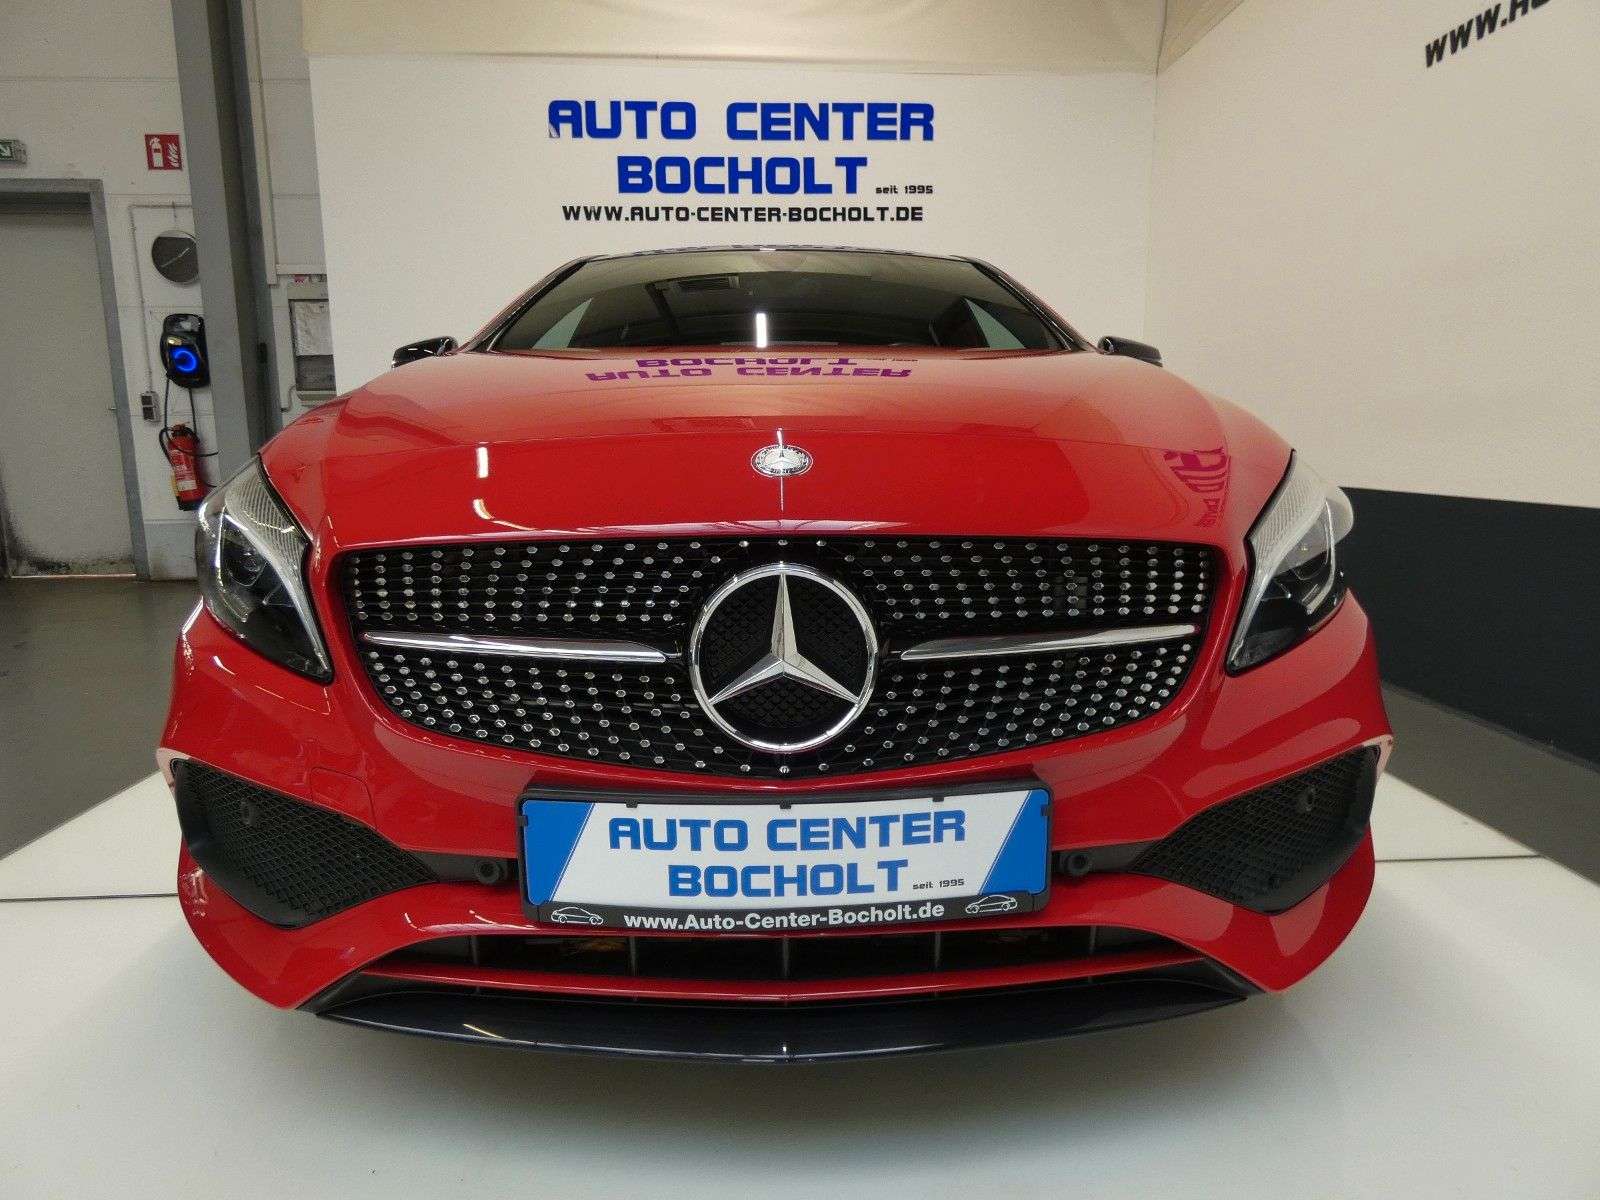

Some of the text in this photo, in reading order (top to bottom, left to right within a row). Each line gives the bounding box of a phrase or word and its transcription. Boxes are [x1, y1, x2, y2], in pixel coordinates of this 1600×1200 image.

[548, 100, 935, 141] AUTO CENTER
[617, 155, 868, 194] BOCHOLT
[875, 184, 934, 194] seit 1995
[562, 205, 924, 222] WWW.AUTO-CENTER-BOCHOLT.DE
[608, 809, 967, 852] AUTO CENTER
[668, 859, 908, 895] BOCHOLT
[912, 878, 966, 890] seit 1995
[623, 899, 946, 931] www.Auto-Center-Bocholt.de
